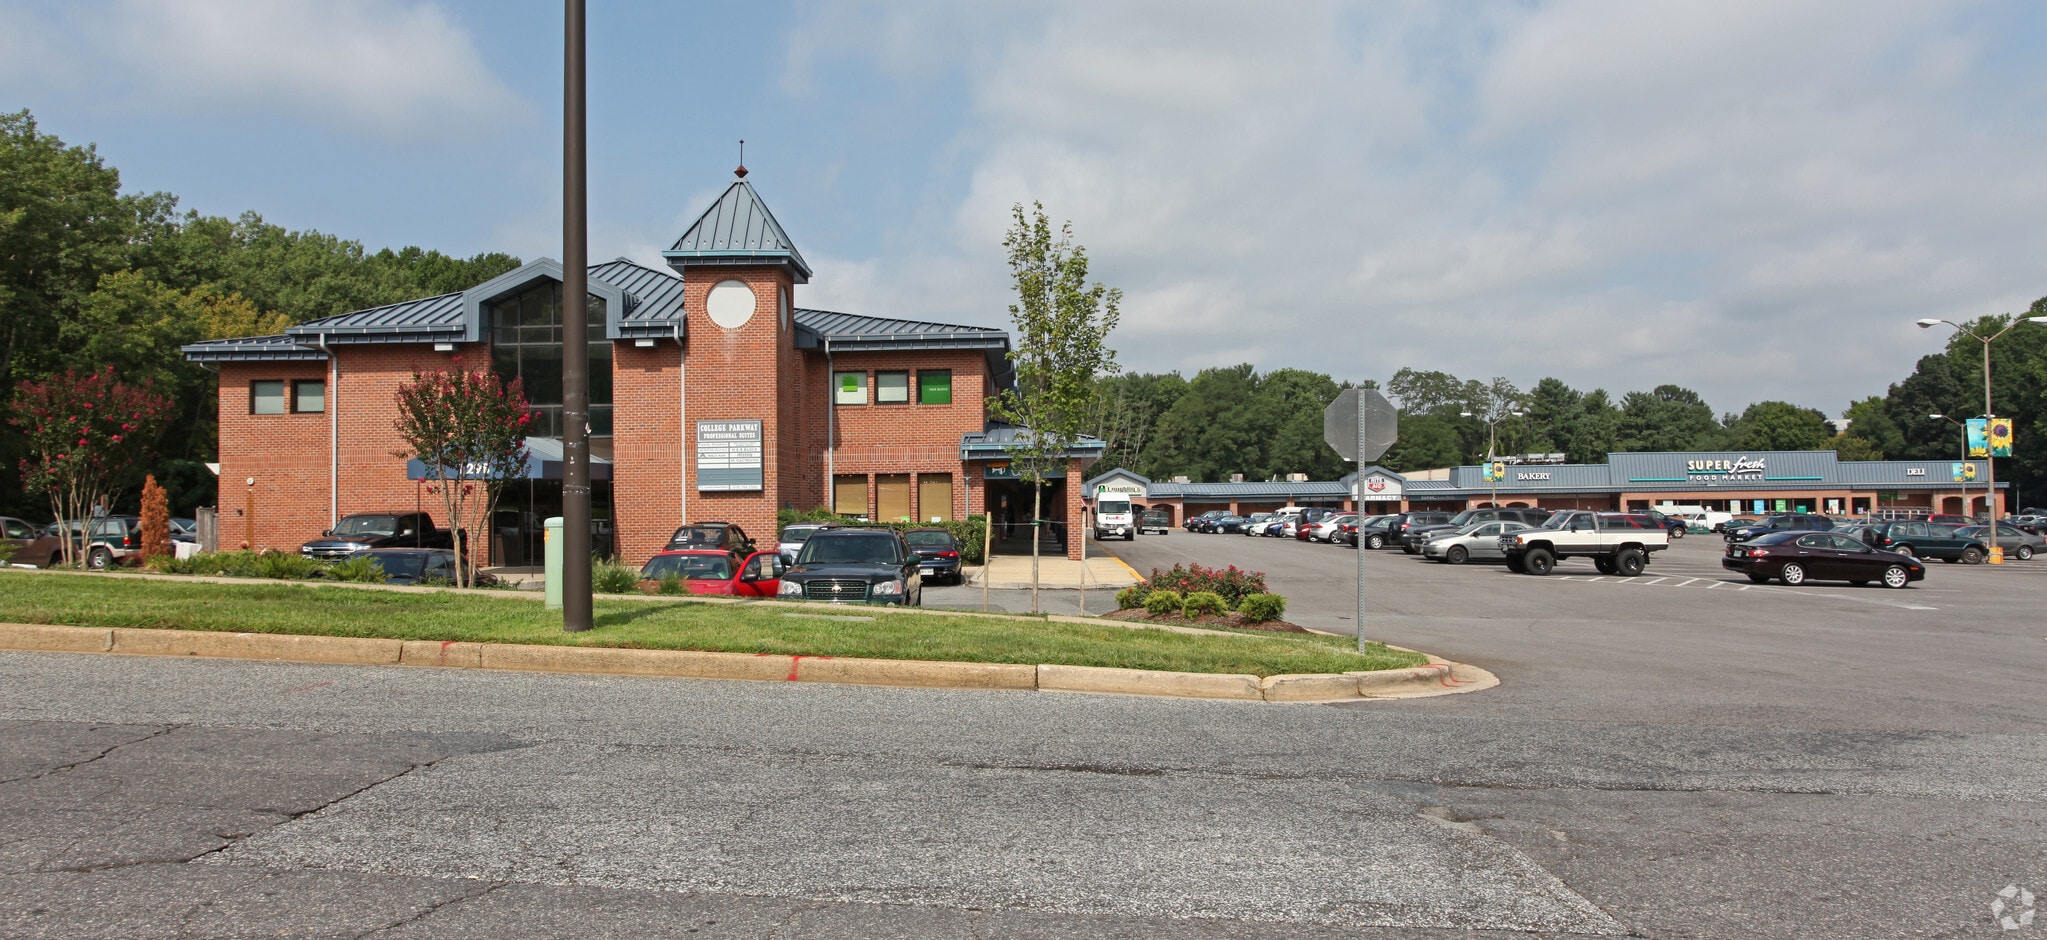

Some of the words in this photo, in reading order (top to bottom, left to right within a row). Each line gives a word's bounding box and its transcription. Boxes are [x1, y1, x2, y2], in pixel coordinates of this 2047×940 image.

[700, 424, 727, 432] COLLEGE
[1688, 460, 1731, 470] SUPER
[1728, 456, 1766, 474] fresh
[1518, 472, 1550, 480] BAKERY
